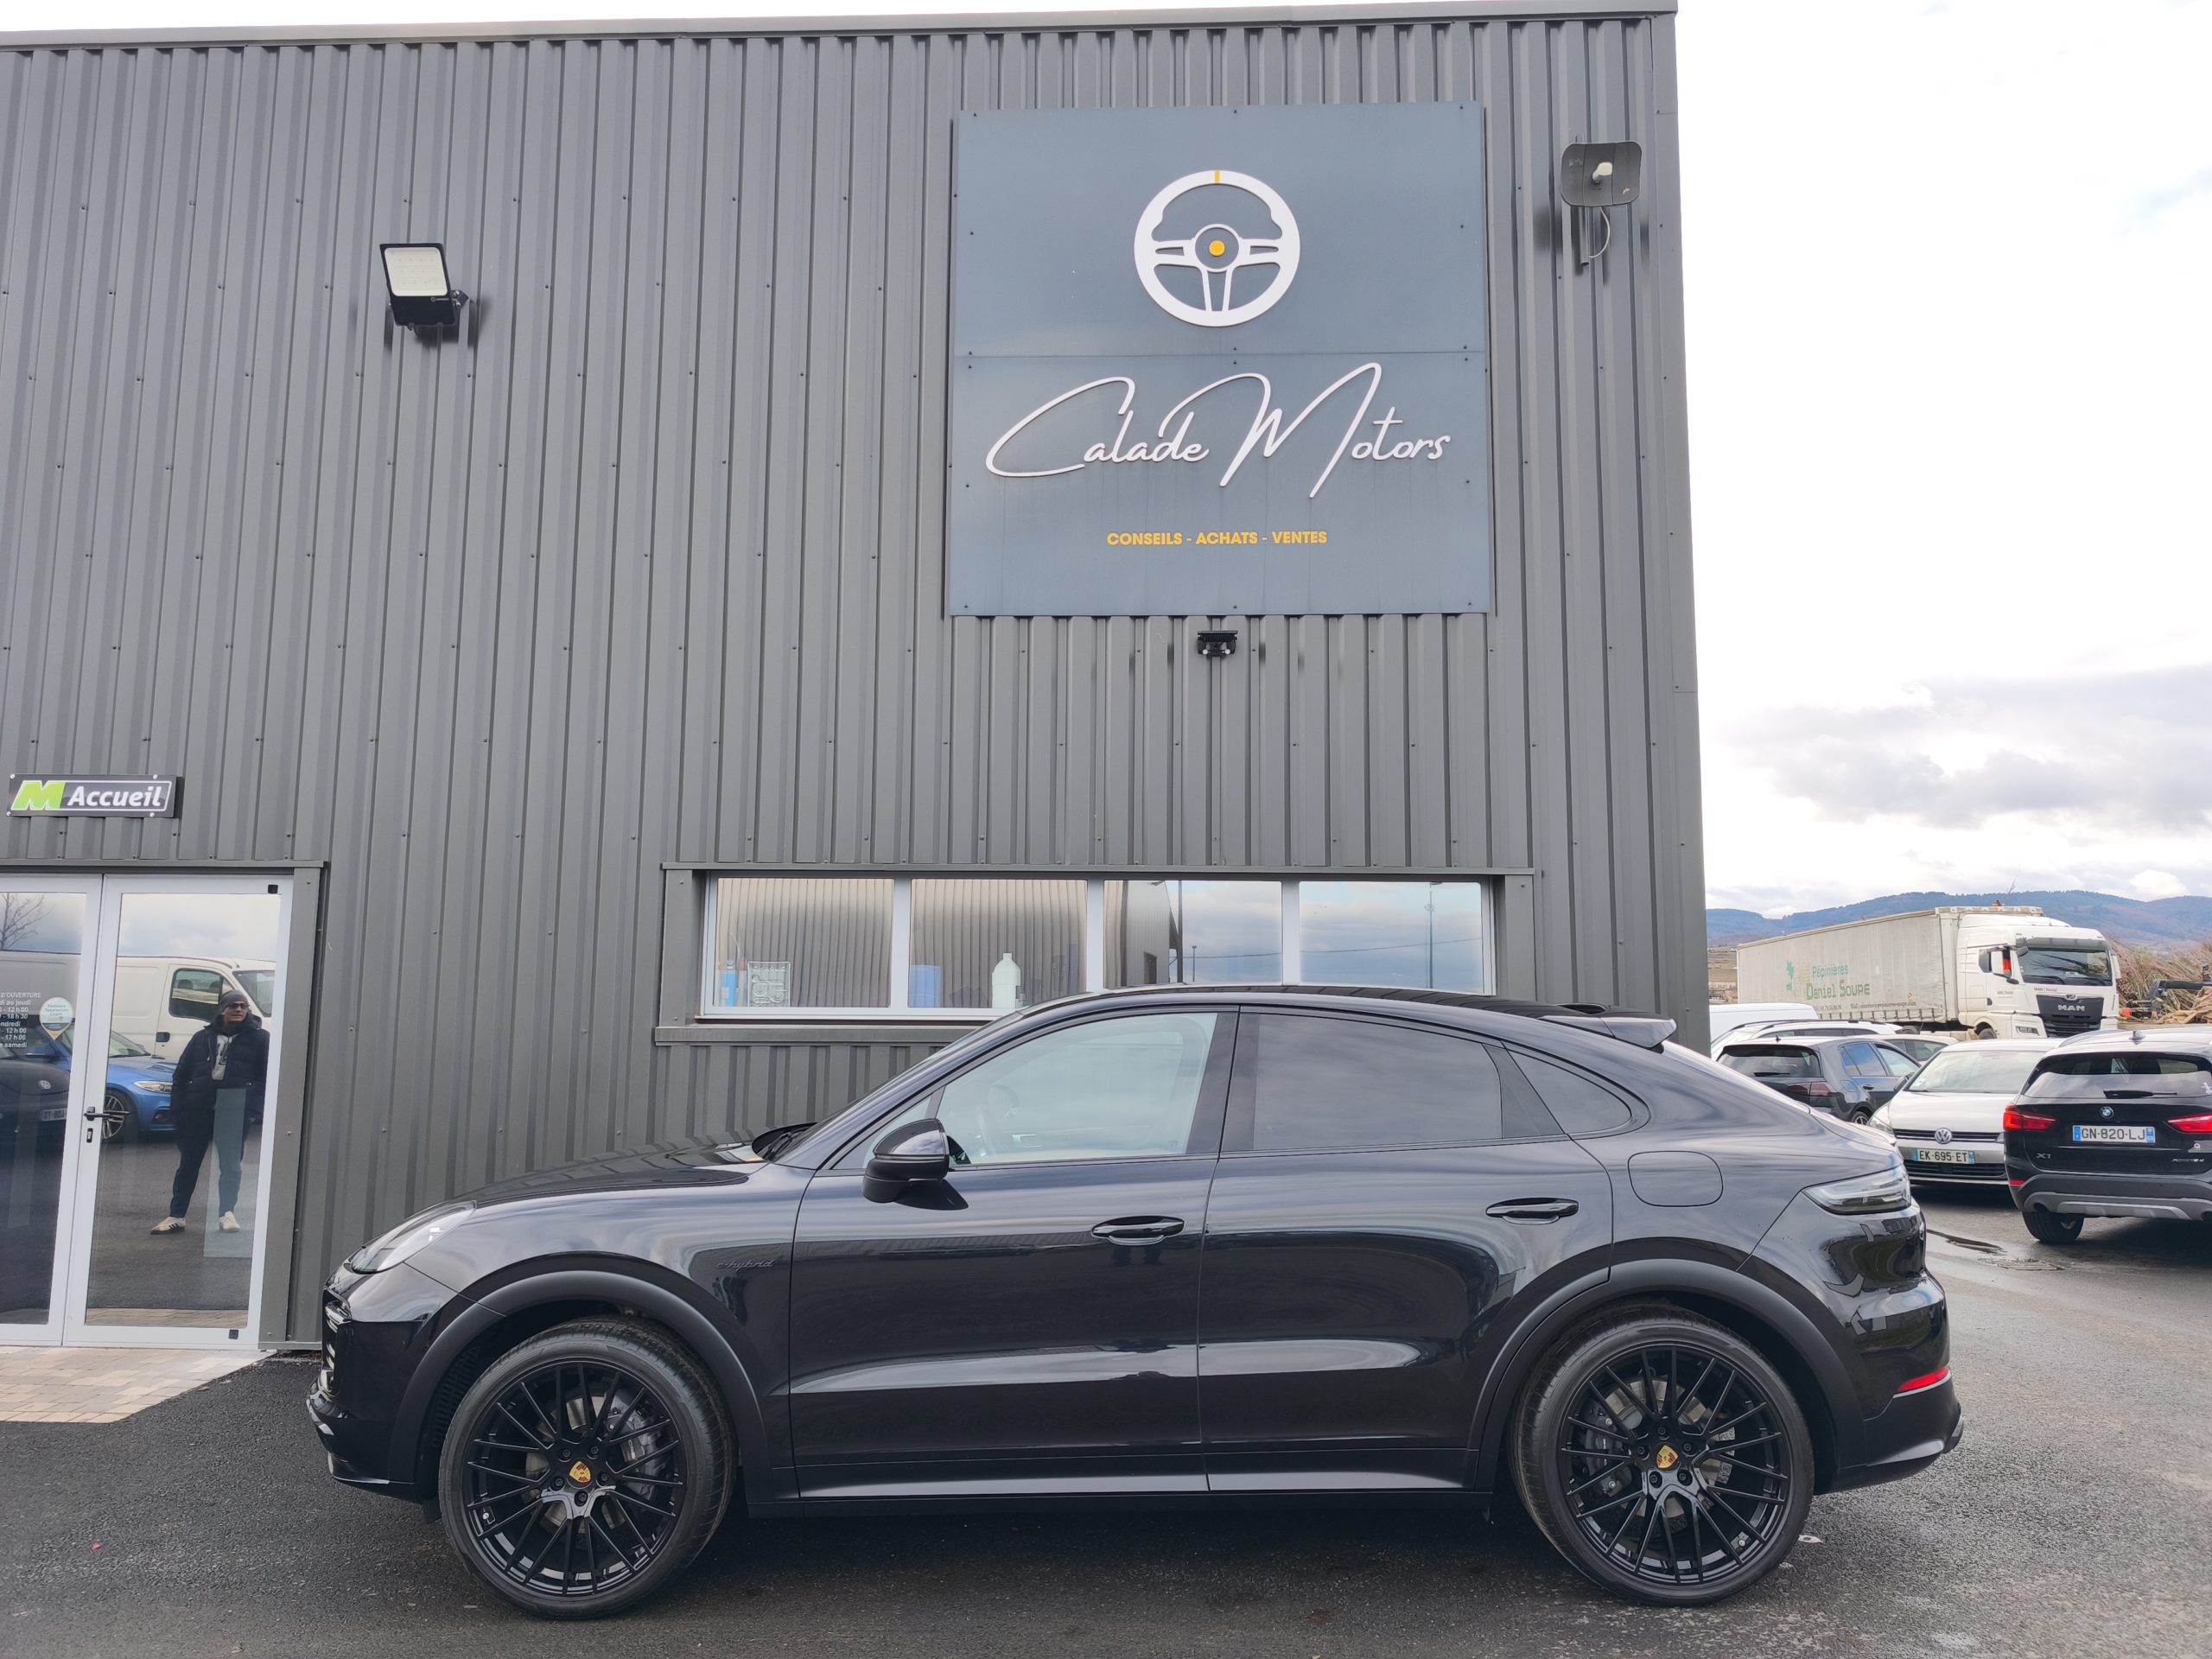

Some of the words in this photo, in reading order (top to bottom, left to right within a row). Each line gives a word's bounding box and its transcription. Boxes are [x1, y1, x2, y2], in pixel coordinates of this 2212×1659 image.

[985, 376, 1210, 477] Calade
[1157, 361, 1451, 499] Motors
[1107, 532, 1183, 545] CONSEILS
[1196, 531, 1258, 545] ACHATS
[1271, 531, 1328, 544] VENTES
[67, 785, 162, 807] Accueil
[1806, 982, 1837, 1000] Daniel
[2081, 1128, 2146, 1141] GN-820-LJ
[1918, 1150, 1967, 1162] EK-695-ET
